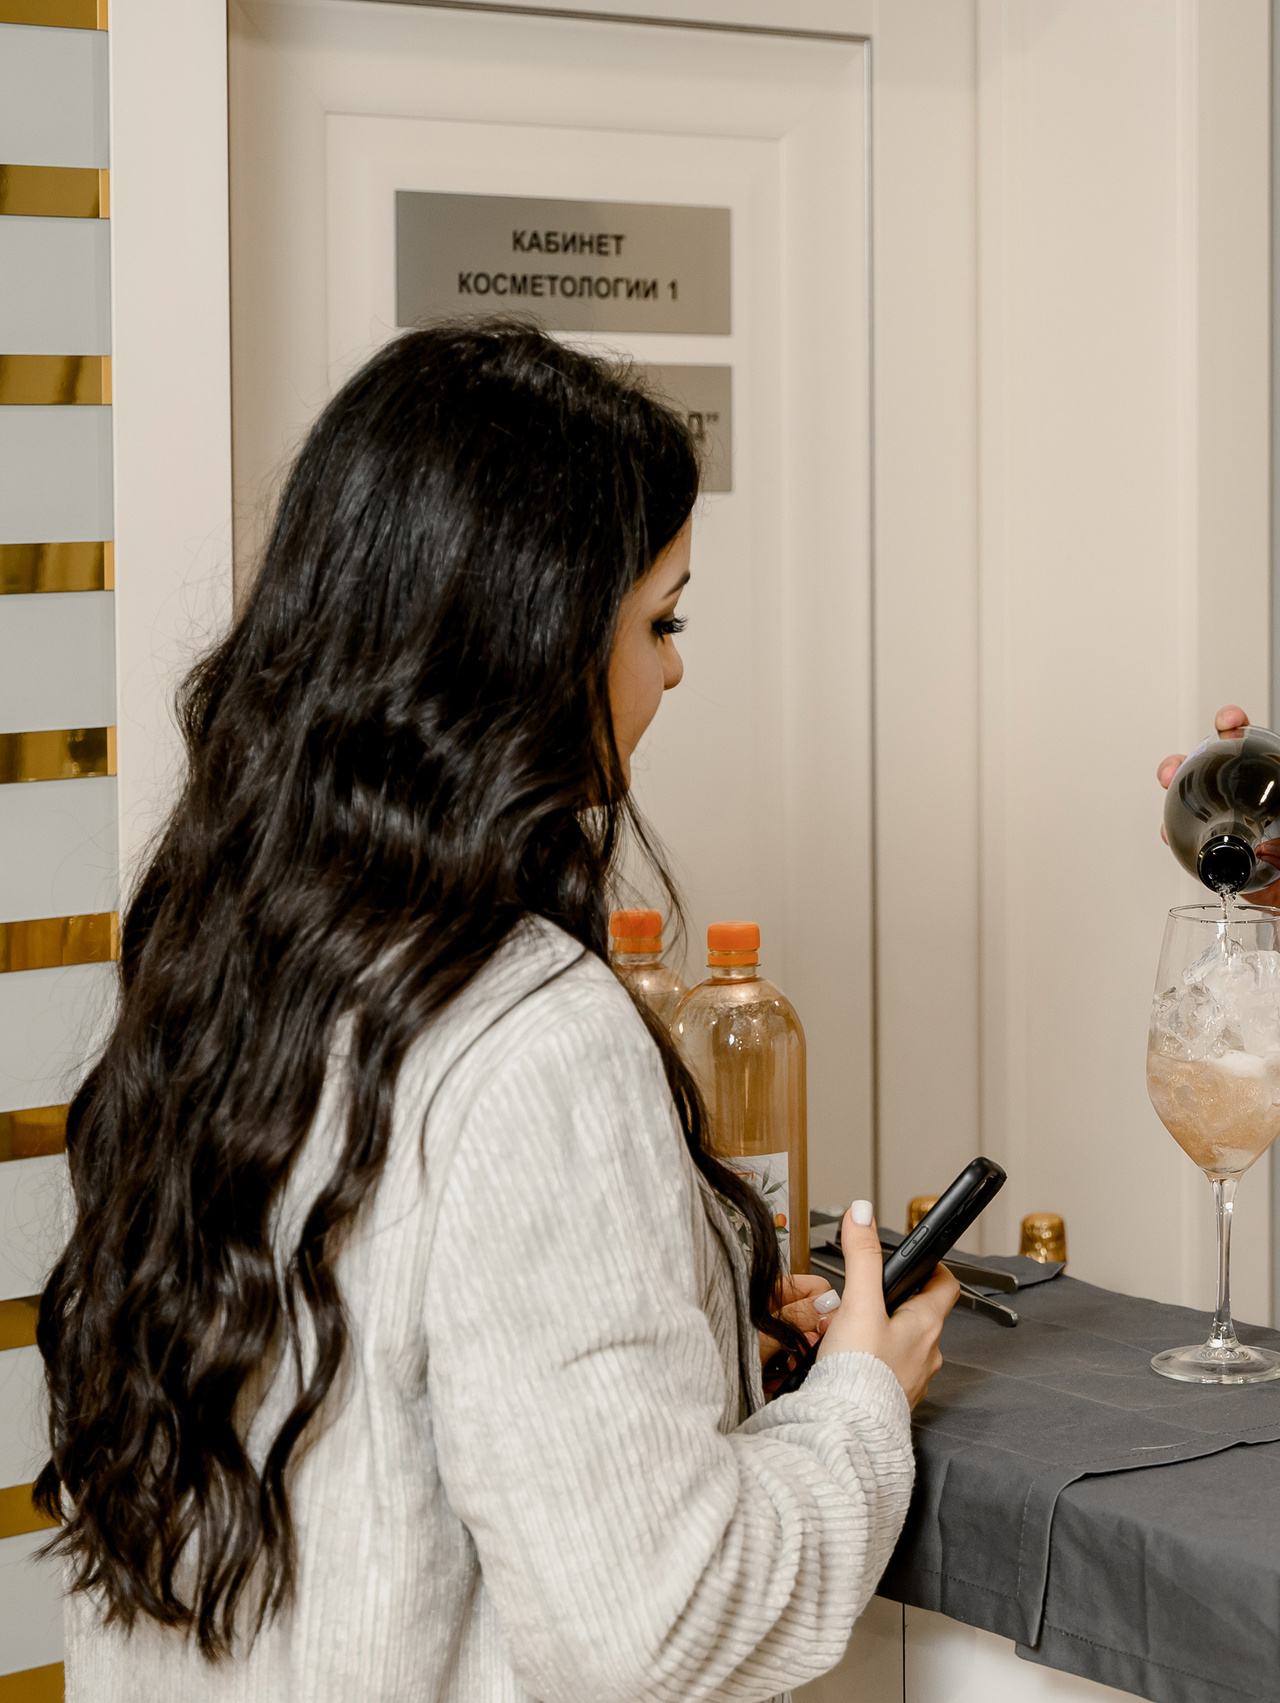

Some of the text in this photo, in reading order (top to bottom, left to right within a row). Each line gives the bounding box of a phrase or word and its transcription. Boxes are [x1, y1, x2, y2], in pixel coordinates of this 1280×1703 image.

[512, 230, 625, 256] КАБИНЕТ
[458, 272, 679, 299] КОСМЕТОЛОГИИ 1
